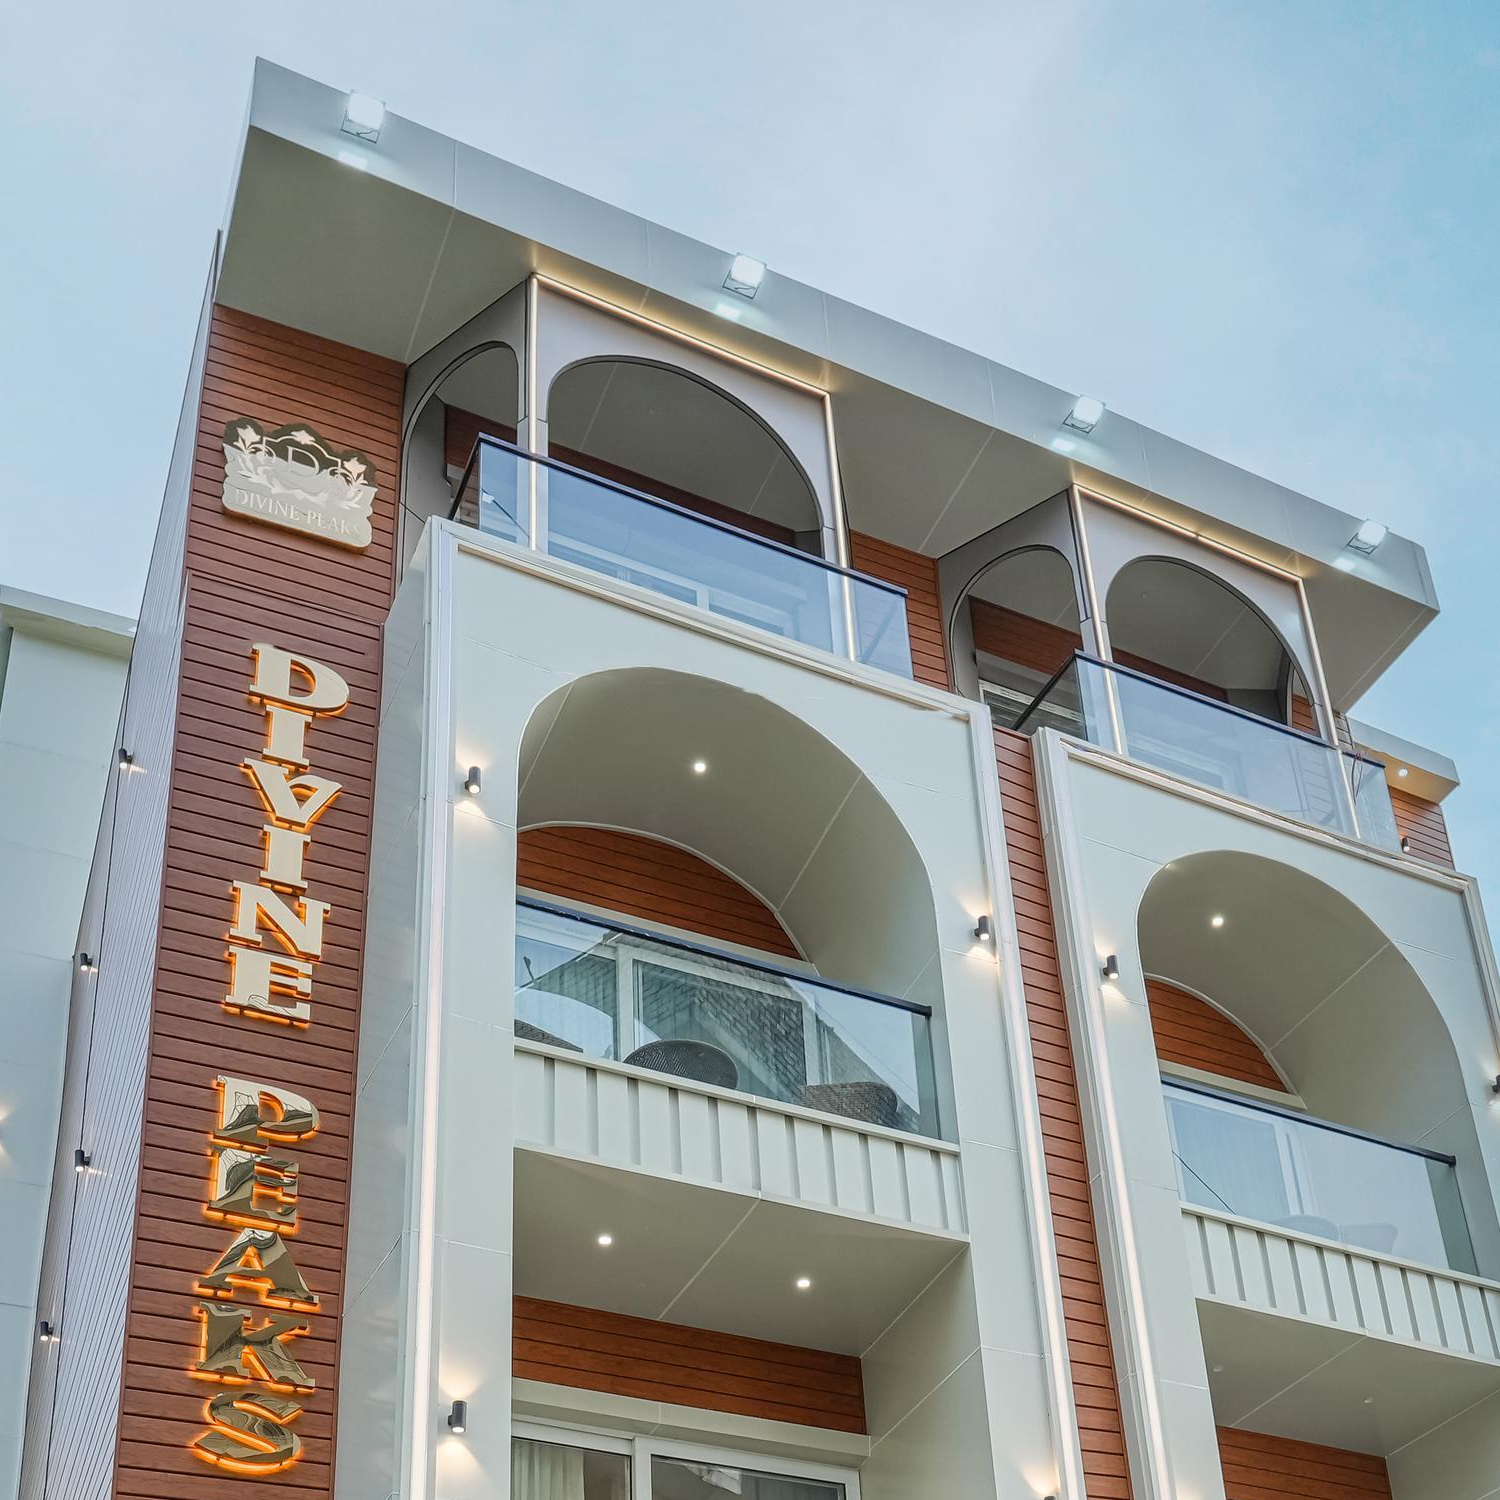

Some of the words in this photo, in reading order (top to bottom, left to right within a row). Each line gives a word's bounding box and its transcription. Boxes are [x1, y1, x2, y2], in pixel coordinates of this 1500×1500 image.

[235, 489, 300, 522] DIVINE
[224, 643, 350, 1026] DIVINE
[194, 1074, 320, 1472] PEAKS
